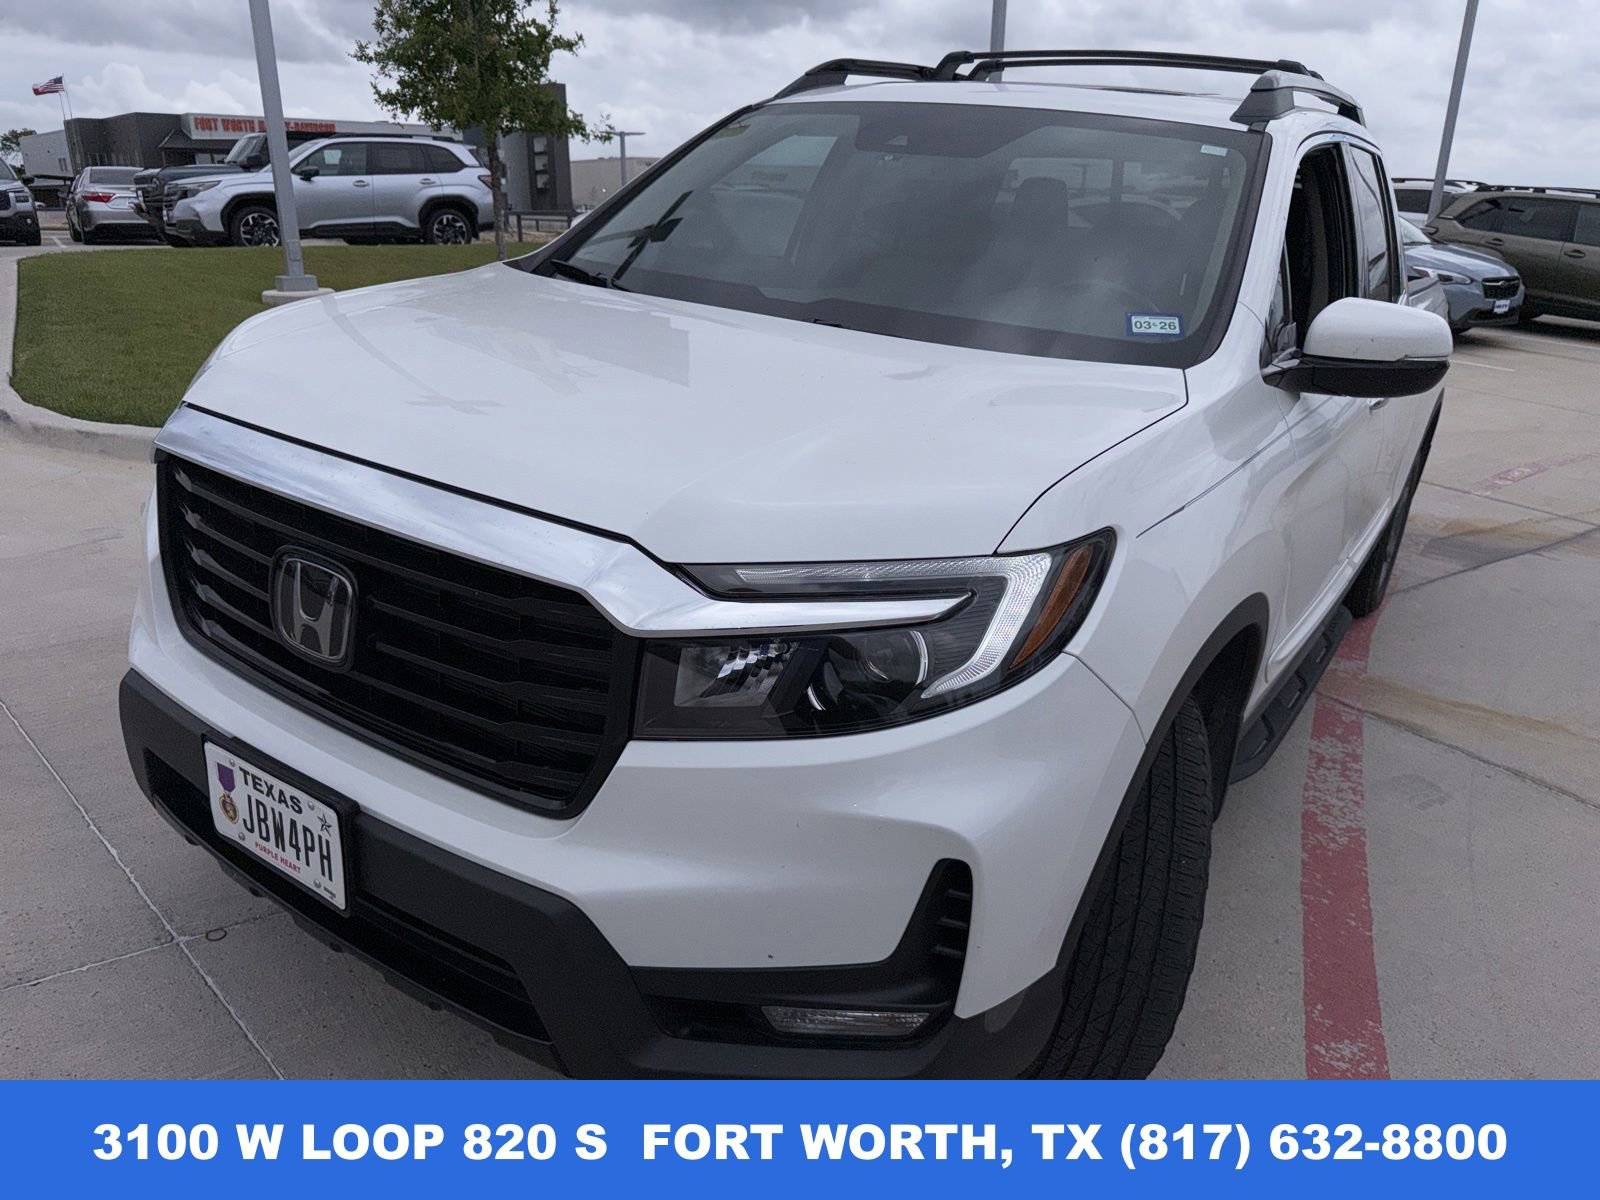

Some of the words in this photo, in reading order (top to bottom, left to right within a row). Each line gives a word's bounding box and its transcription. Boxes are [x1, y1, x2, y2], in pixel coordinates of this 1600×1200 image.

[193, 117, 219, 131] FORT
[220, 118, 255, 133] WORTH
[238, 766, 304, 815] TEXAS
[242, 794, 333, 883] JBW4PH
[254, 841, 278, 861] PURPLE
[280, 855, 302, 875] HEART
